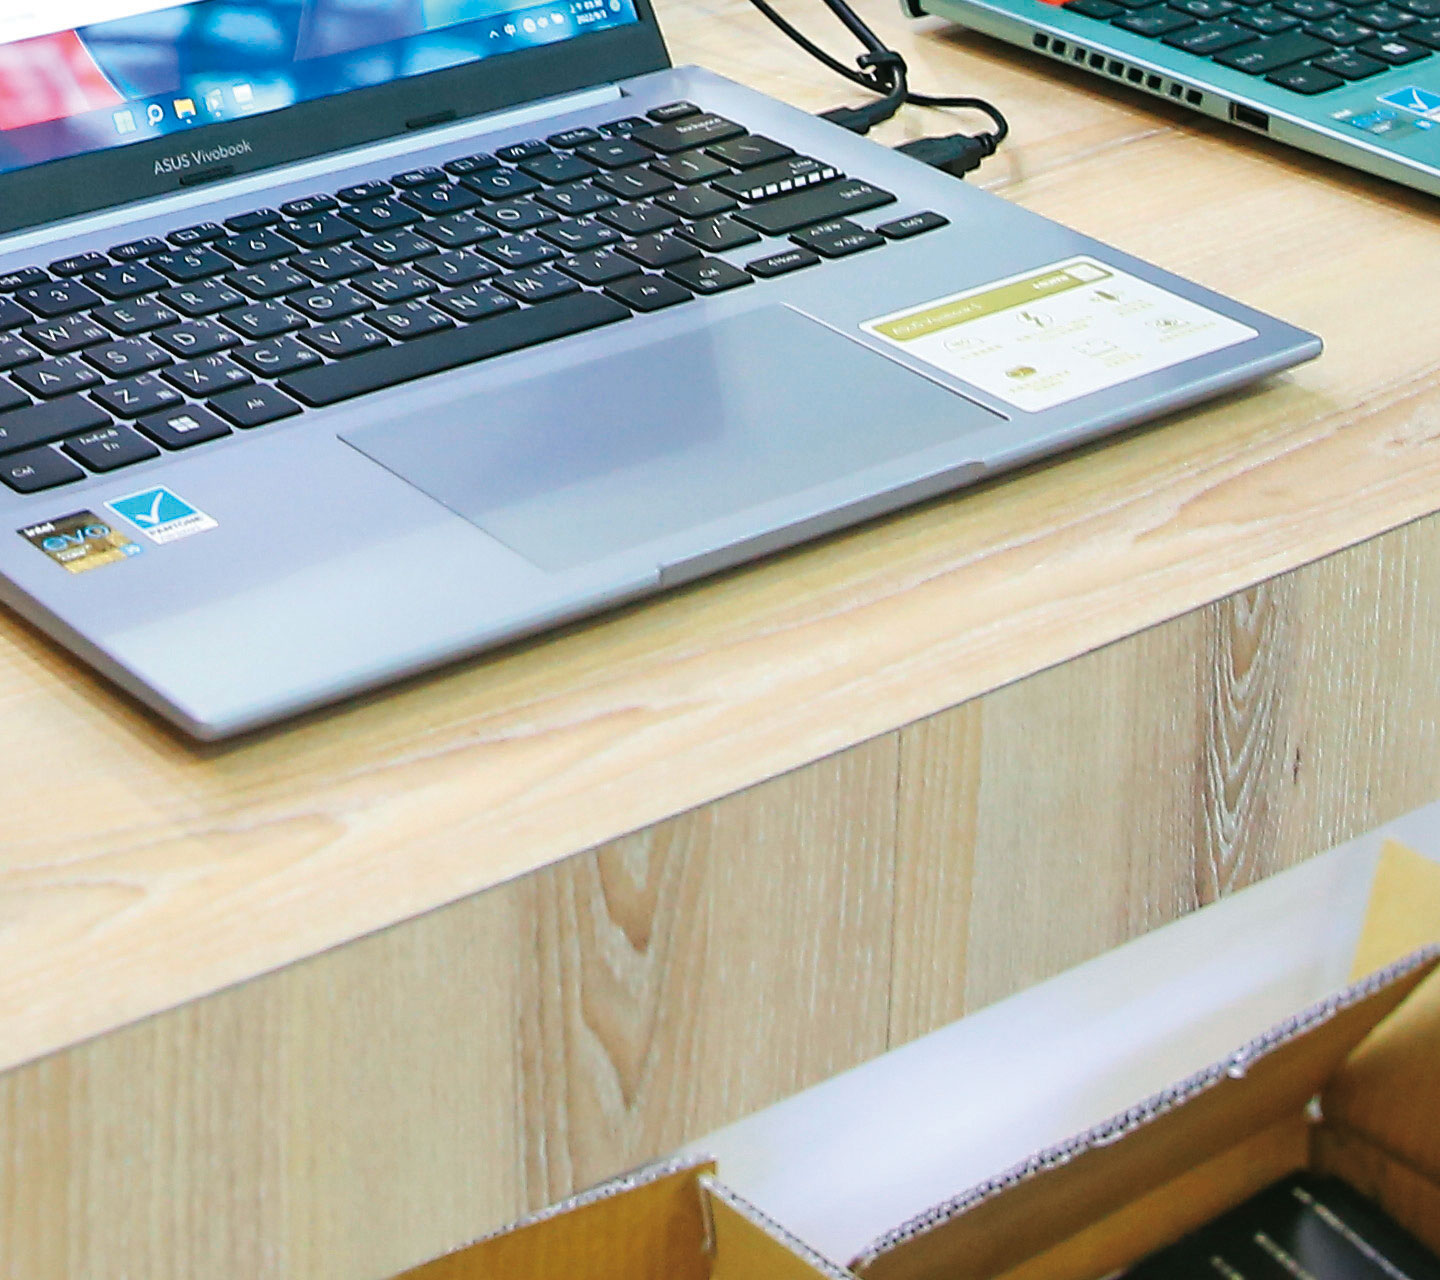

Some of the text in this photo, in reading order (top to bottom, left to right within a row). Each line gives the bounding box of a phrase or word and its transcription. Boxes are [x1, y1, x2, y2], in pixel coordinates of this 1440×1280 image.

[153, 139, 253, 176] ASUS Vivobook
[308, 222, 323, 234] 7
[559, 229, 582, 241] L
[250, 239, 267, 251] 6
[373, 239, 397, 253] U
[497, 244, 522, 258] K
[309, 257, 331, 270] Y
[442, 261, 458, 275] J
[122, 271, 137, 284] 4
[246, 274, 267, 287] T
[372, 277, 399, 292] H
[513, 277, 544, 293] M
[50, 290, 69, 302] 3
[180, 292, 204, 305] R
[450, 295, 478, 310] N
[114, 309, 136, 323] E
[242, 314, 259, 327] F
[38, 325, 70, 342] W
[172, 332, 196, 346] D
[319, 330, 342, 345] V
[106, 350, 129, 364] S
[254, 349, 280, 363] C
[37, 371, 61, 385] A
[183, 368, 209, 383] X
[113, 388, 139, 405] Z
